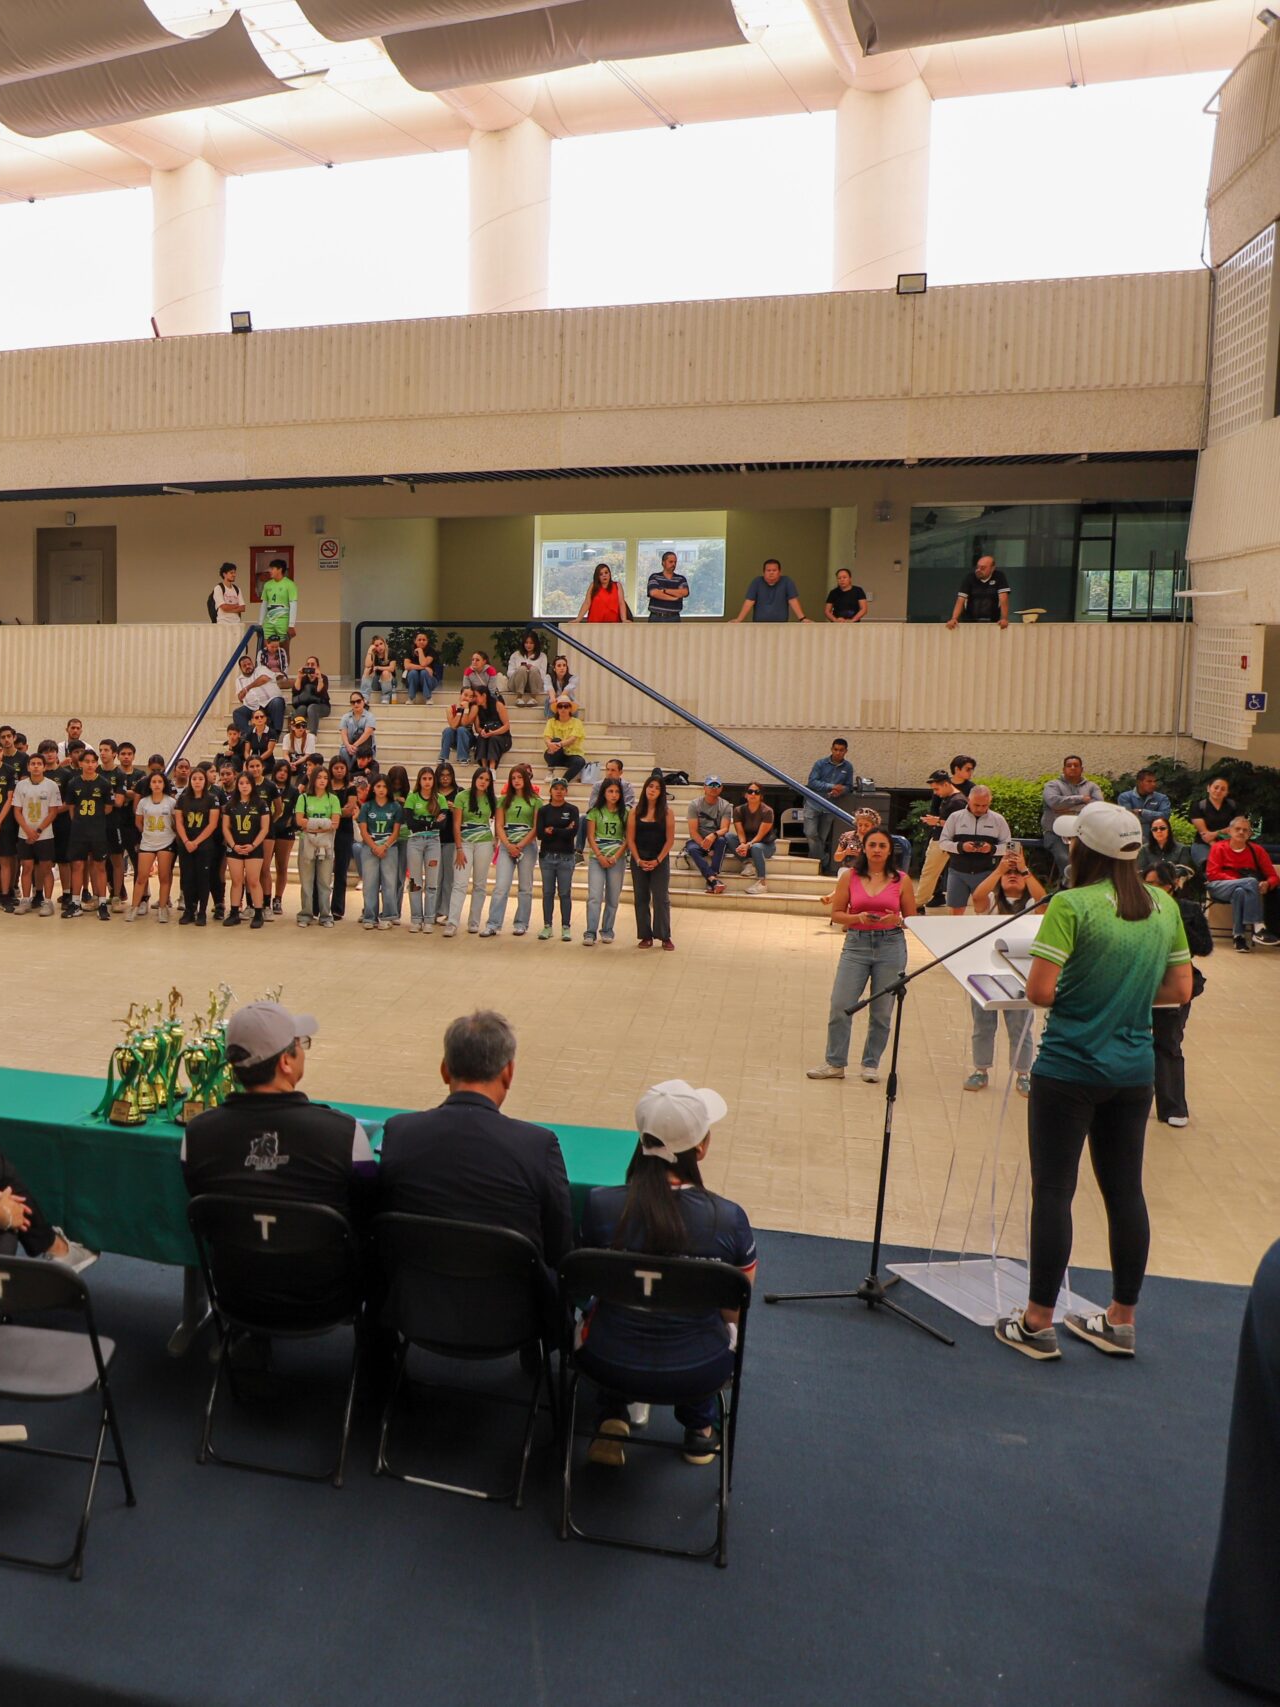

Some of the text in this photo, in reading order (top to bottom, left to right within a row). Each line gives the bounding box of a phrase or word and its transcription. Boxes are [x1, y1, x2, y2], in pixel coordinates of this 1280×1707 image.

[79, 799, 96, 816] 33
[515, 806, 522, 818] 7
[186, 811, 204, 829] 99
[235, 814, 252, 831] 16
[375, 820, 388, 833] 17
[604, 822, 617, 836] 13
[253, 1213, 277, 1240] T
[634, 1270, 662, 1296] T
